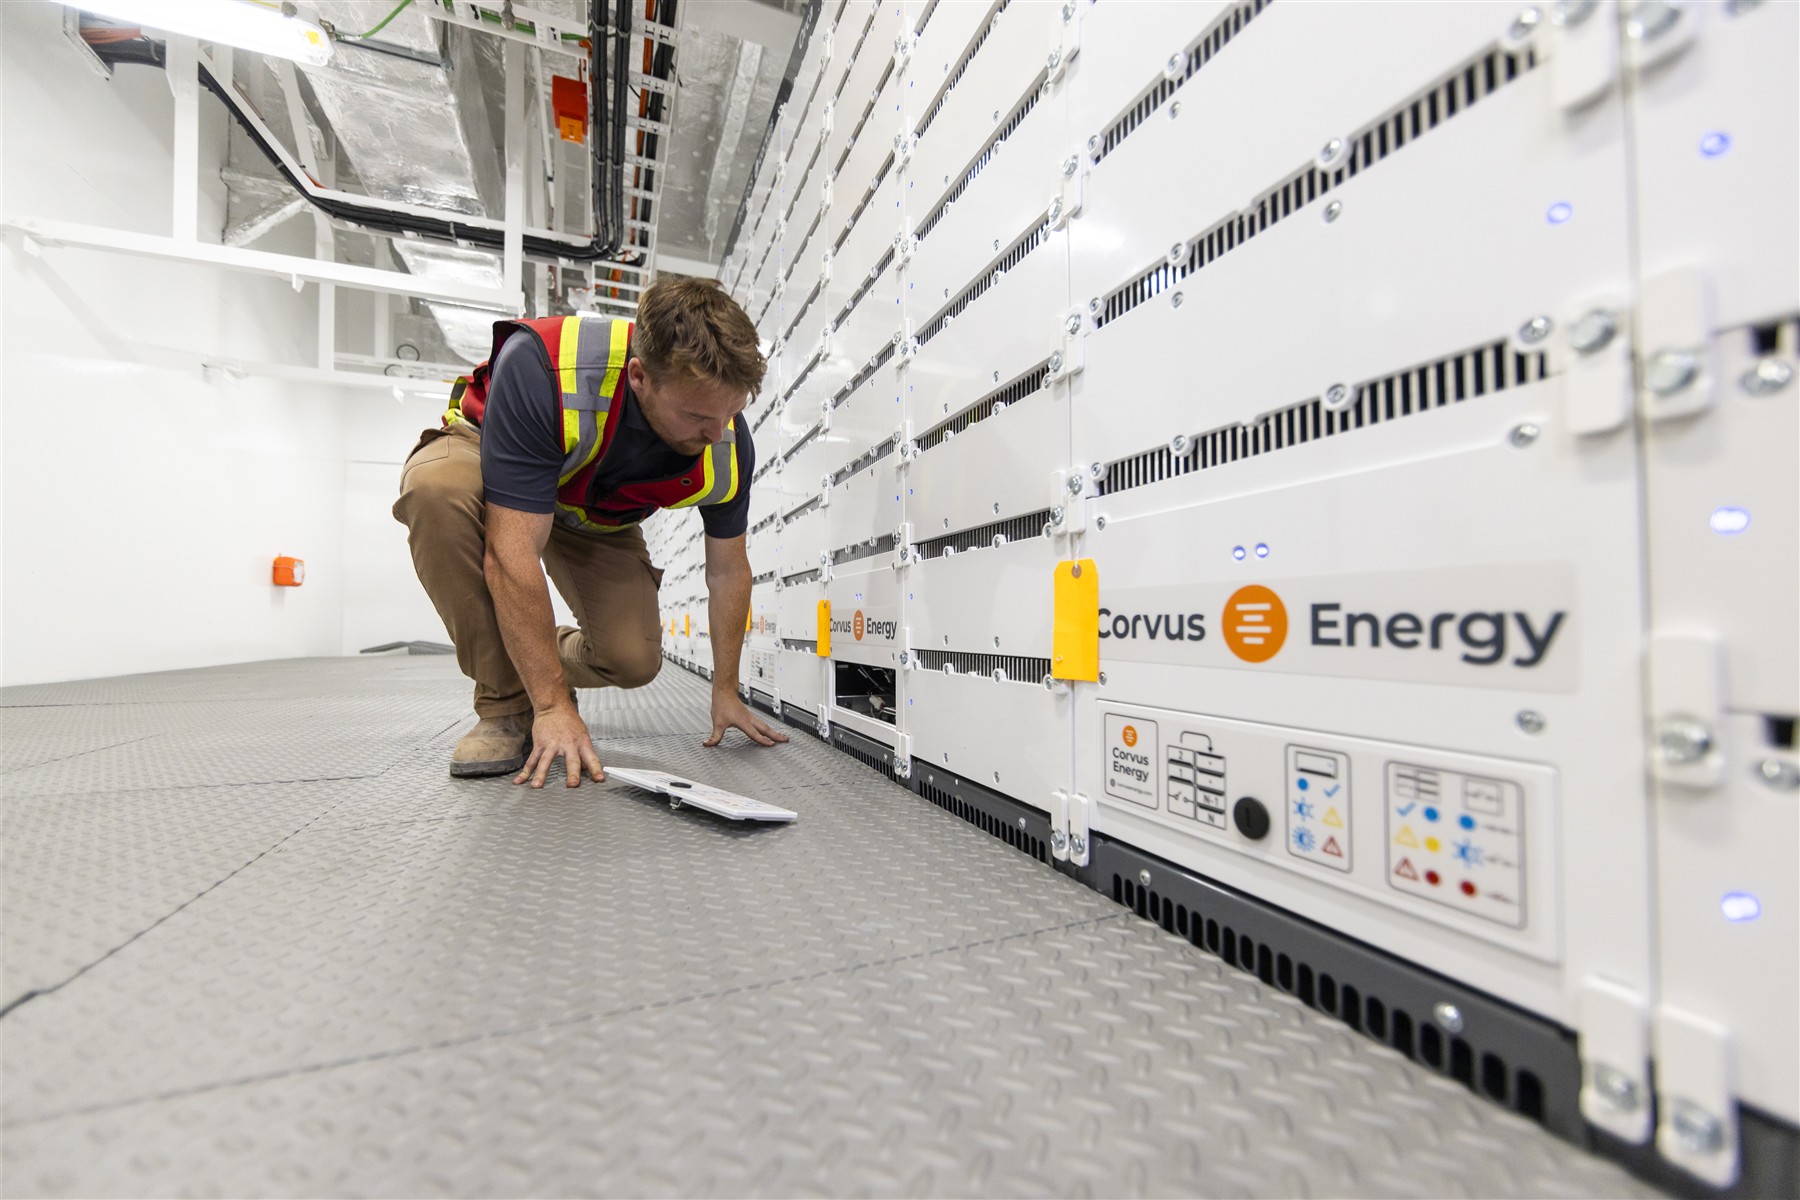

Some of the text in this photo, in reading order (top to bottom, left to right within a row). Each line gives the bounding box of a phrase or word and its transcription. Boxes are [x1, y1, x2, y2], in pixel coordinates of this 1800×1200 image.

[829, 617, 897, 640] Corvus Energy
[1098, 603, 1567, 667] Corvus Energy
[1112, 747, 1149, 766] Corvus
[1113, 760, 1149, 782] Energy
